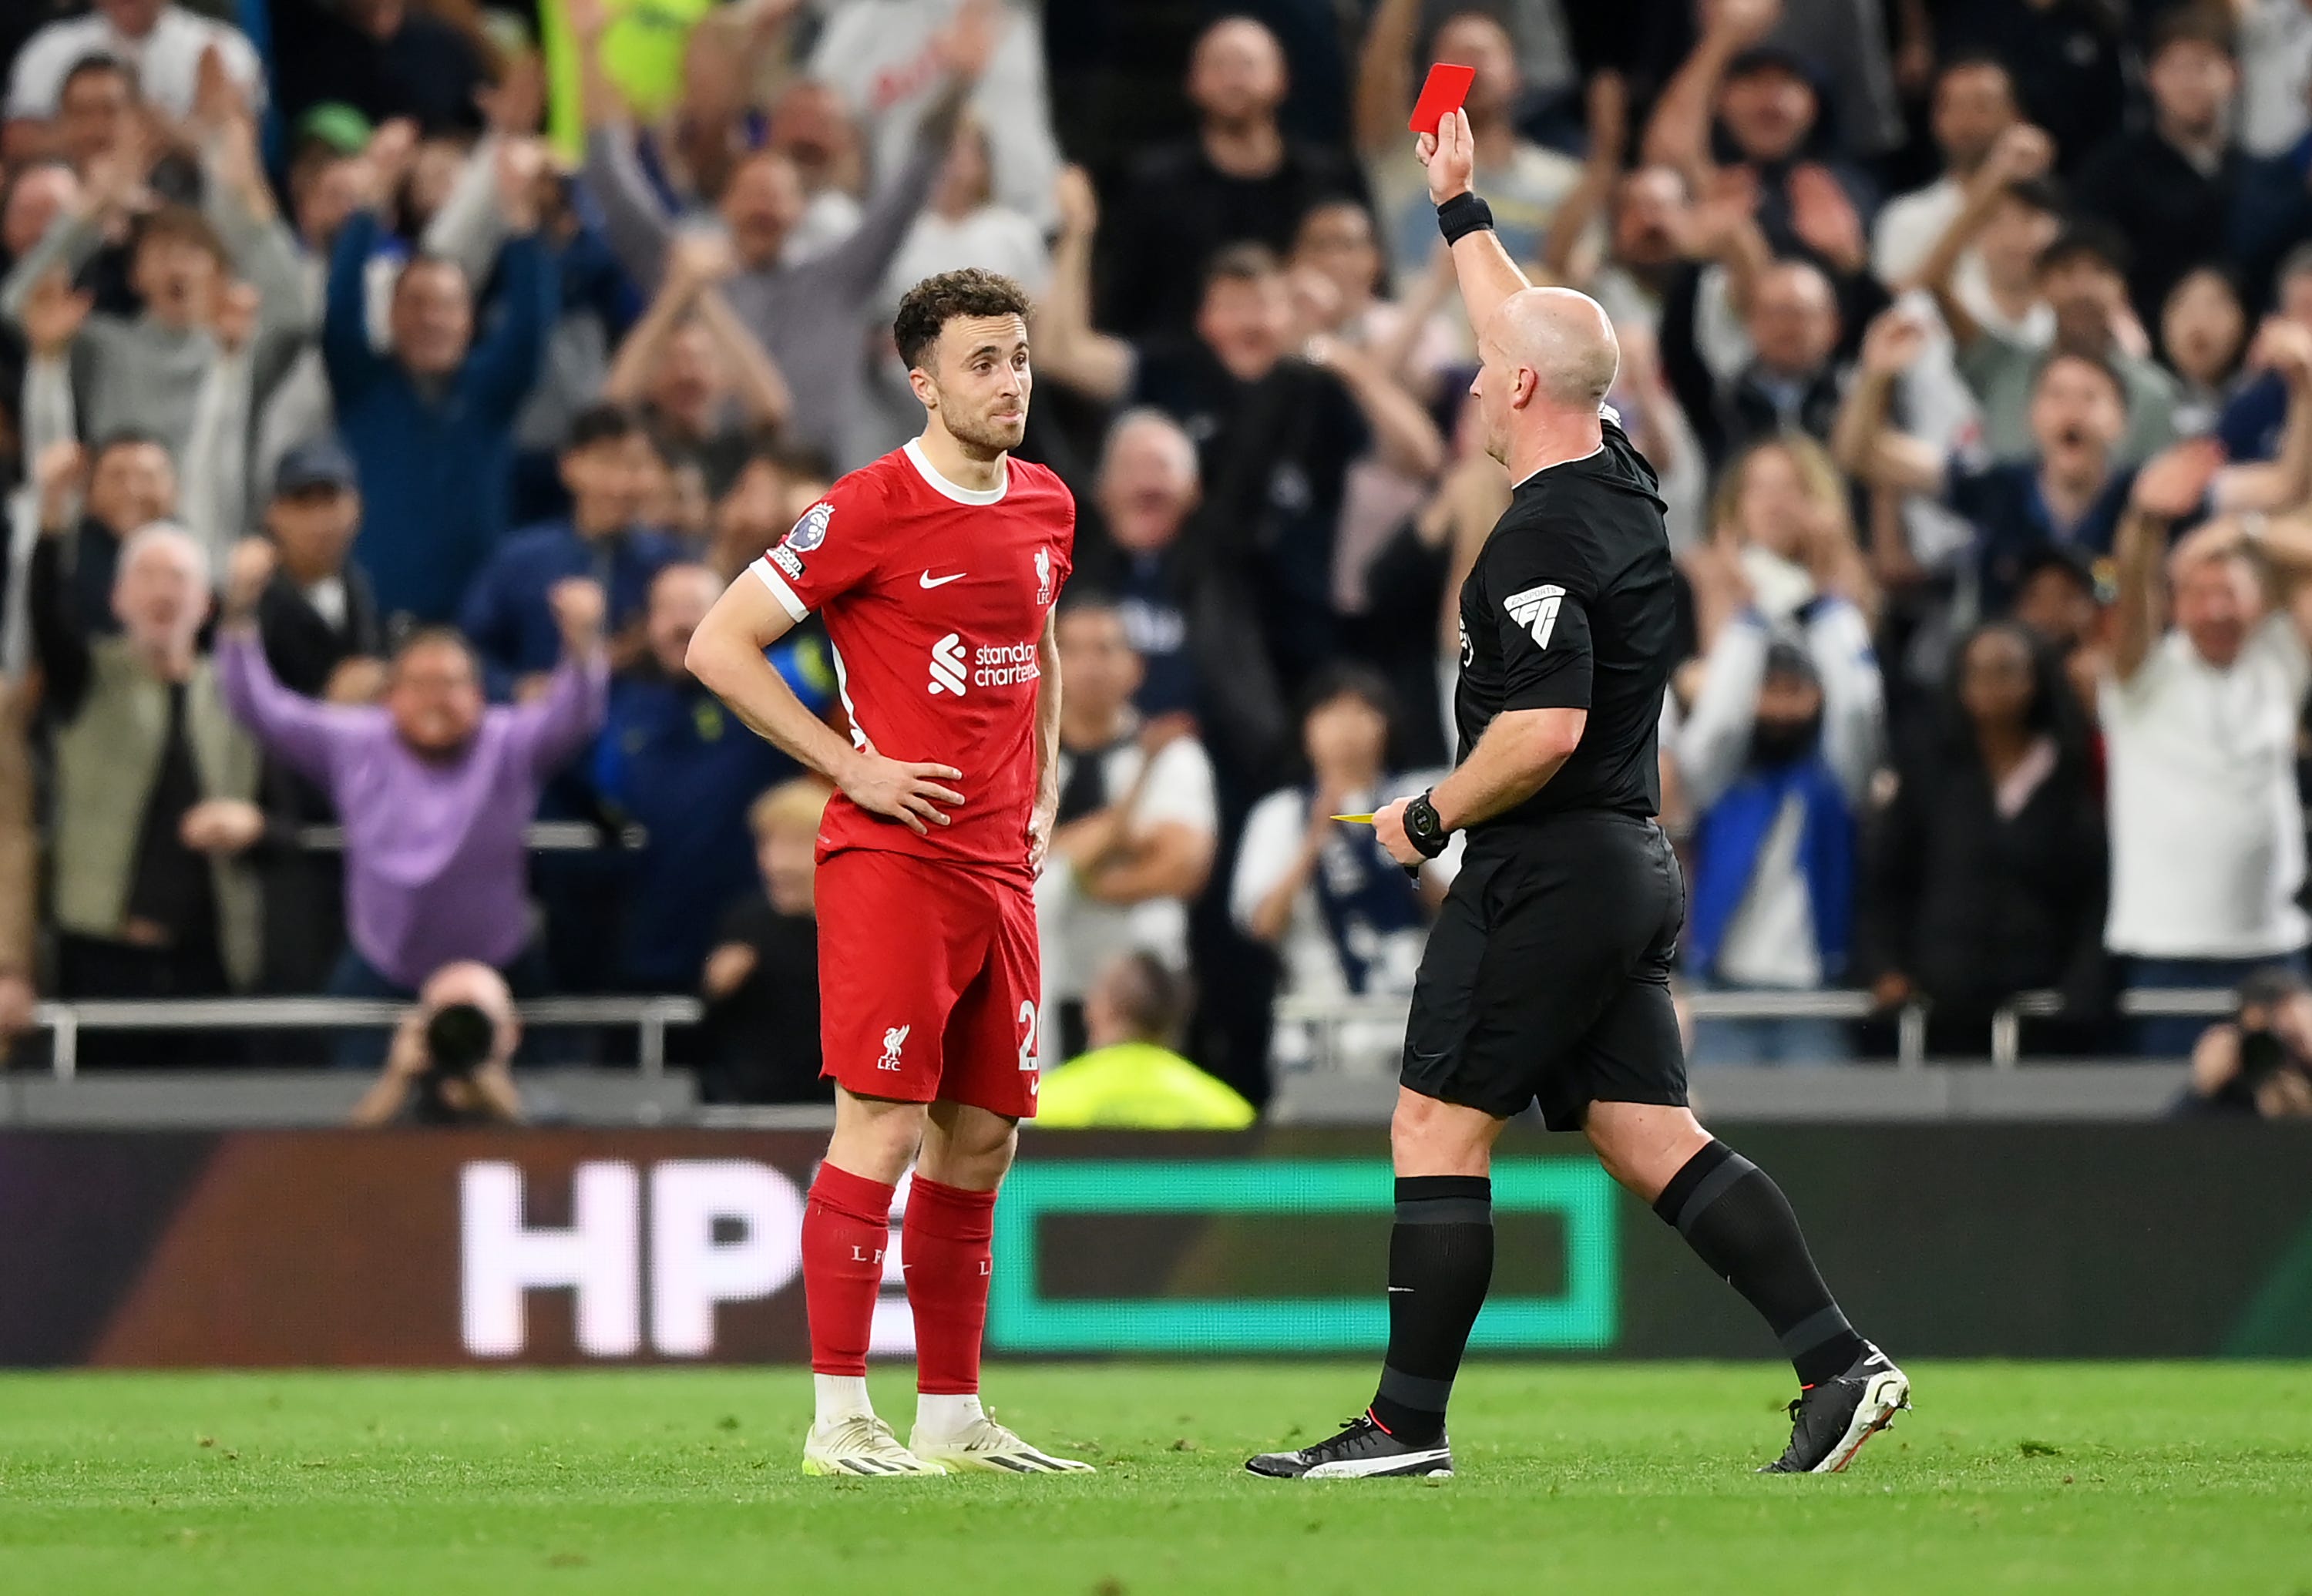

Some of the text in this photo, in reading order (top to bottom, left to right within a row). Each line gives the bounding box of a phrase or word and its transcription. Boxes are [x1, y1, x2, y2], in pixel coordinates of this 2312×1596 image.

[1037, 592, 1050, 605] LFC
[1524, 587, 1557, 600] SPORTS
[975, 641, 1037, 665] standa
[1018, 1000, 1040, 1070] 2
[877, 1058, 901, 1071] LFC
